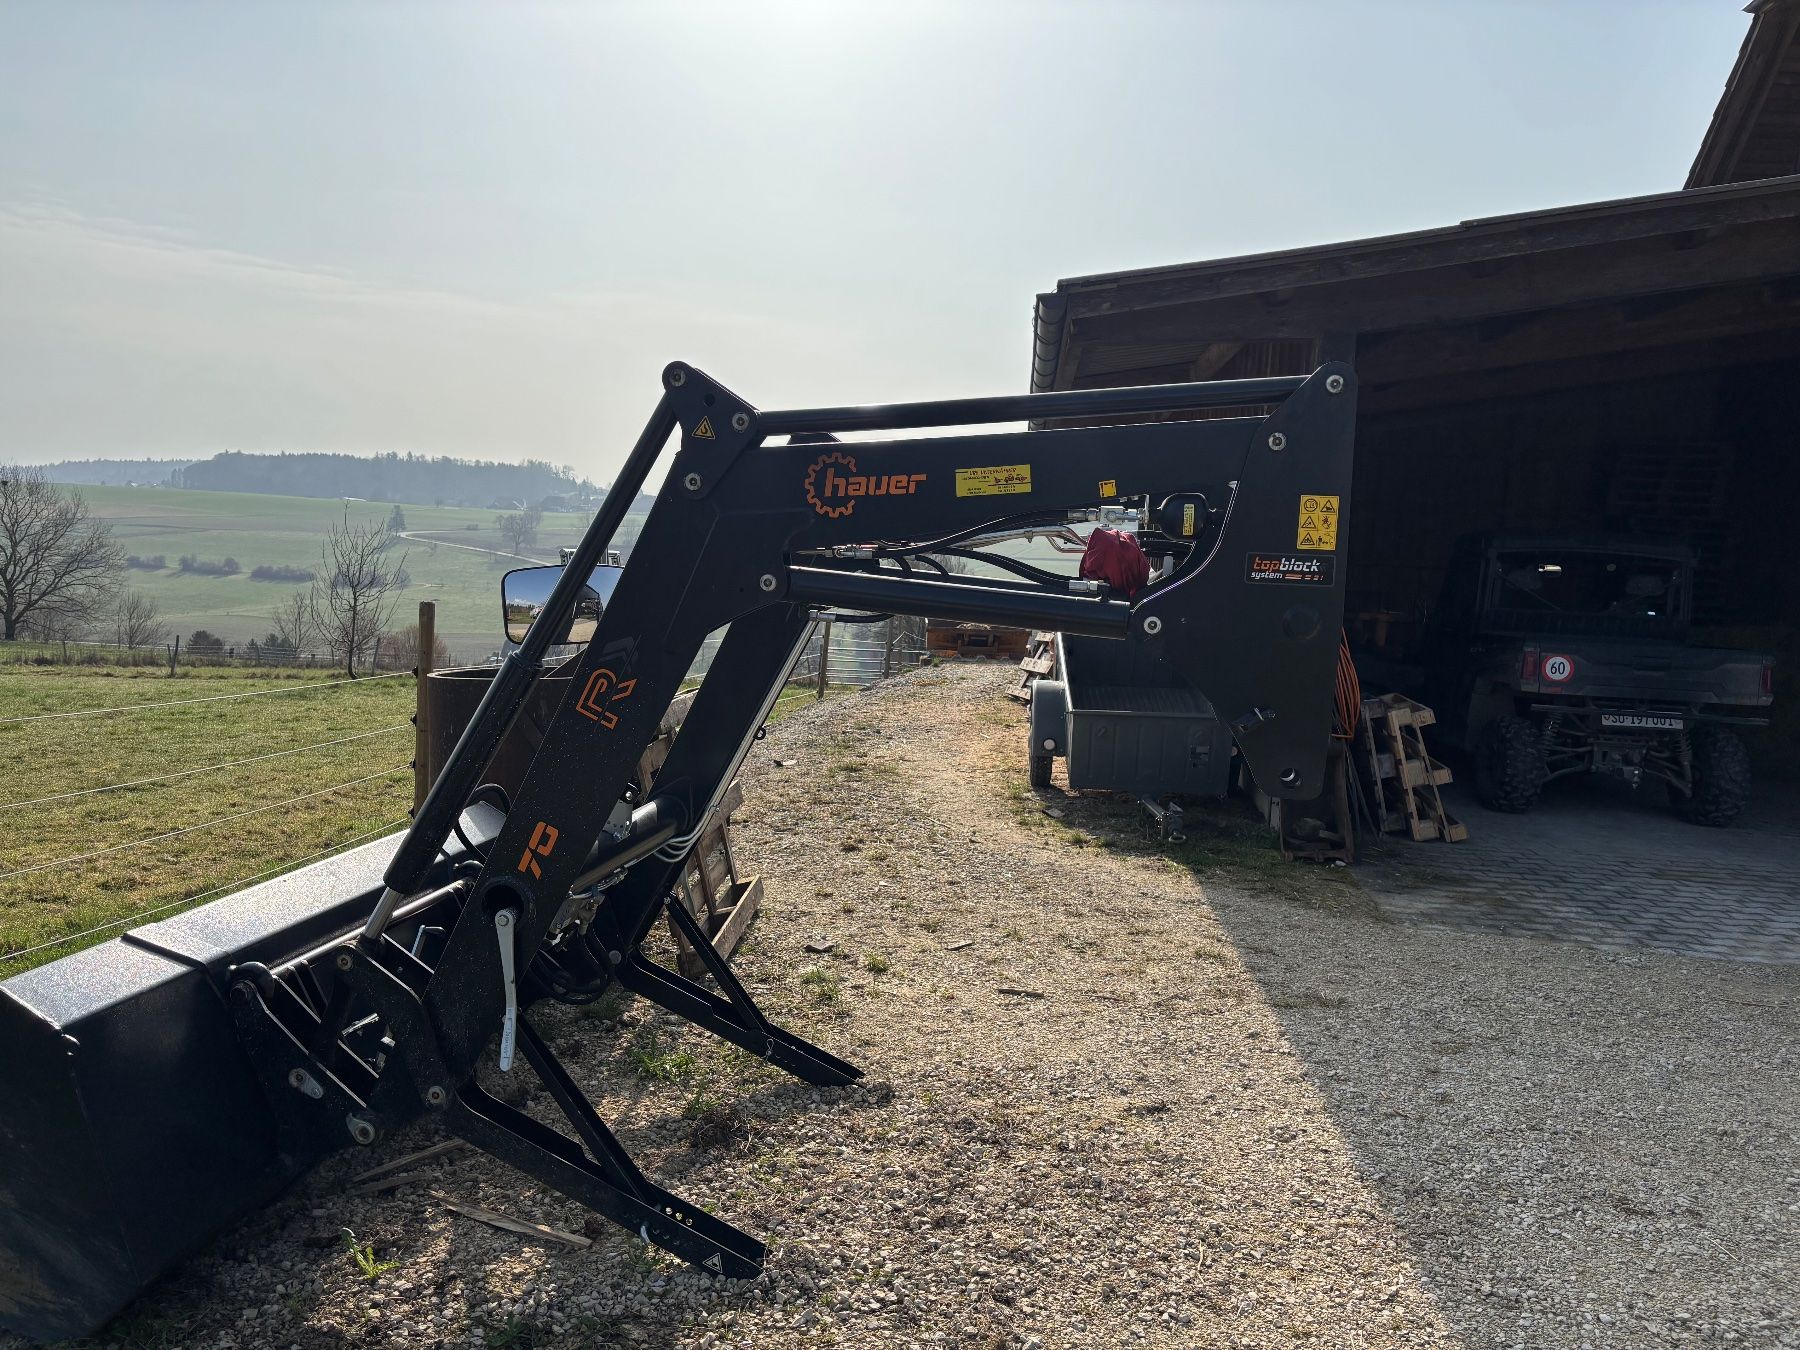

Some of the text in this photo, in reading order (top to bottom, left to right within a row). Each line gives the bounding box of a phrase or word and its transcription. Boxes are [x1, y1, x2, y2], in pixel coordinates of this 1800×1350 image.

[824, 467, 927, 497] hauer
[1253, 556, 1321, 572] topblock
[1250, 570, 1283, 580] system
[1550, 661, 1566, 675] 60
[517, 821, 559, 880] 70
